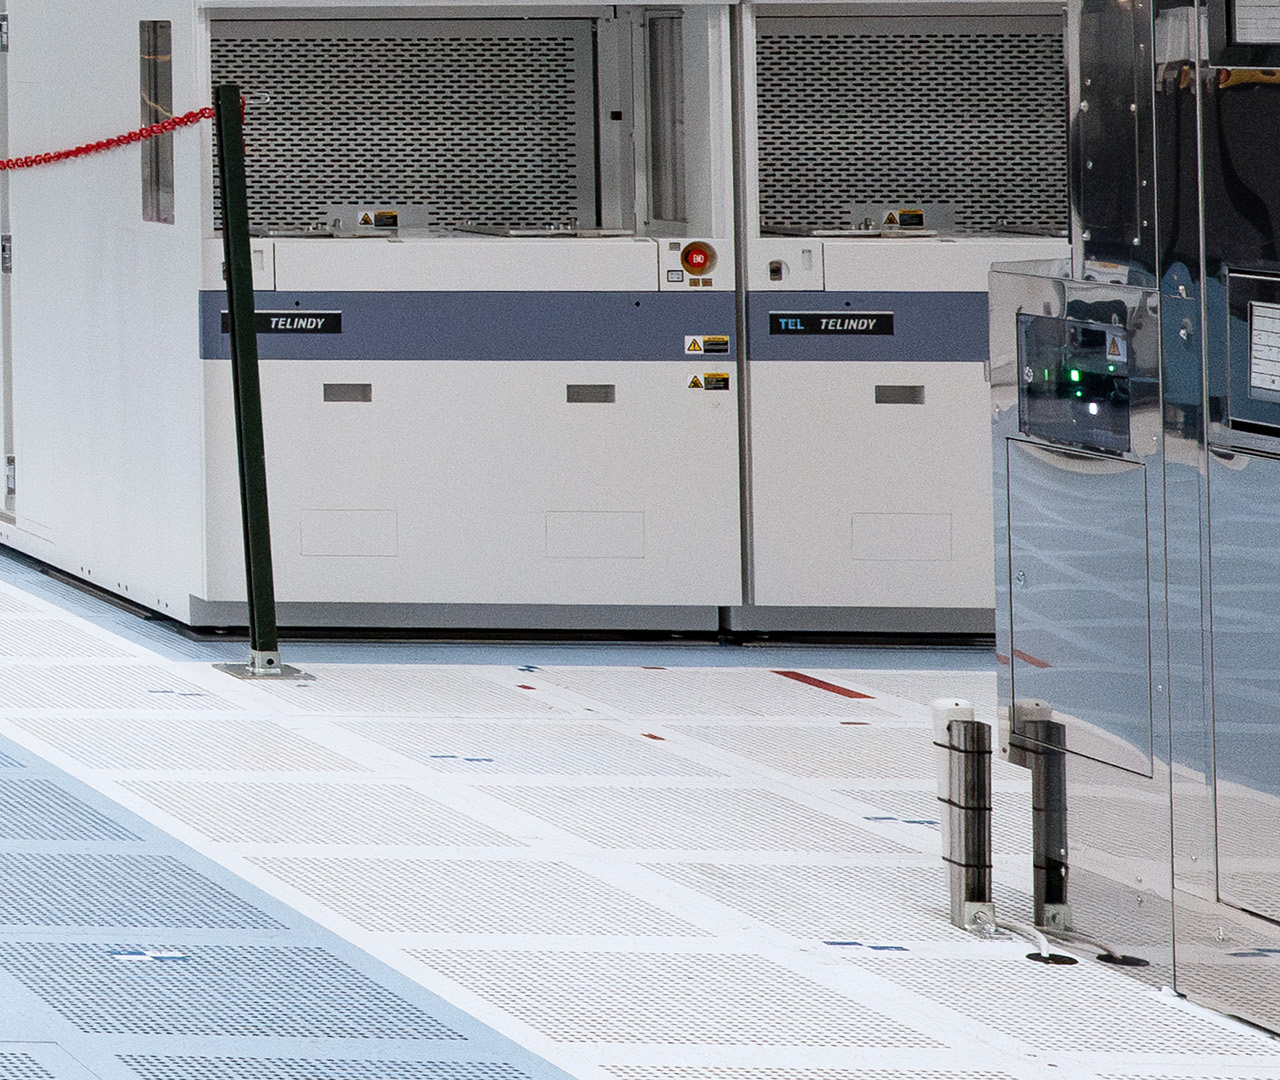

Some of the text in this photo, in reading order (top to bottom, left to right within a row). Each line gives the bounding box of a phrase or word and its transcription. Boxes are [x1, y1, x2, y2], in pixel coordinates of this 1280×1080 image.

[270, 317, 325, 329] TELINDY
[778, 318, 876, 330] TEL TELINDY
